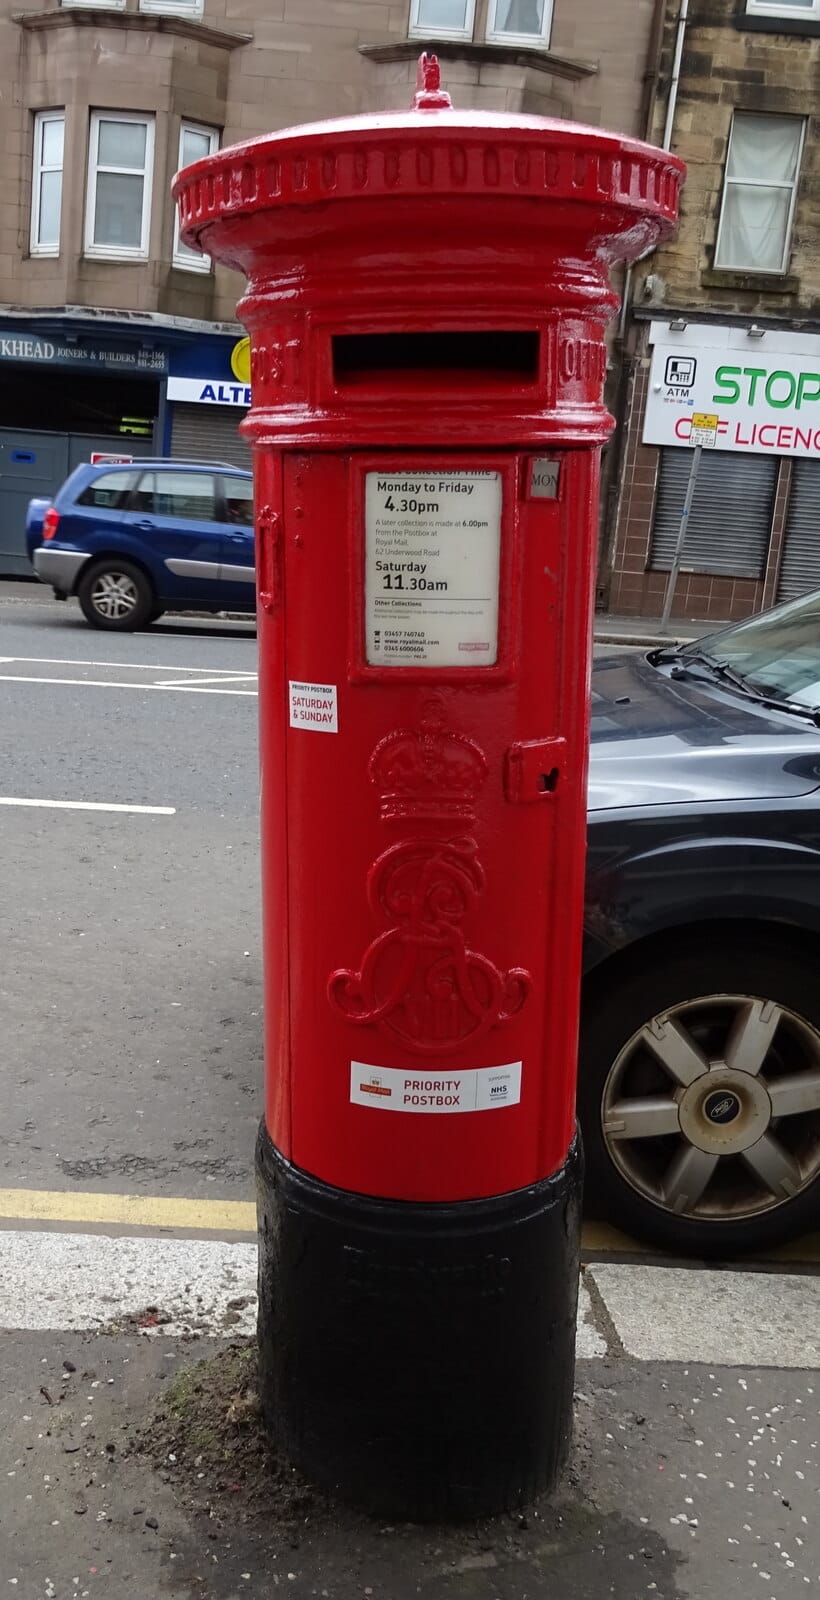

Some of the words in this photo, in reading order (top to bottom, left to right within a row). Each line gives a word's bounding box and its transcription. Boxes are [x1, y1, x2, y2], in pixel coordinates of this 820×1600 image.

[0, 339, 55, 359] KHEAD
[57, 347, 88, 359] JOINERS
[99, 352, 136, 363] BUILDERS
[666, 387, 690, 397] ATM
[377, 481, 421, 494] Monday
[424, 483, 435, 492] to
[439, 482, 474, 495] Friday
[384, 495, 439, 514] 4.30pm
[462, 520, 489, 529] 6.00pm
[393, 529, 403, 537] the
[404, 529, 430, 537] Postbox
[376, 538, 393, 547] Royal
[385, 549, 422, 557] Underwood
[375, 561, 427, 574] Saturday
[383, 574, 448, 591] 11.30am
[392, 600, 422, 608] Collections
[292, 696, 334, 710] SATURDAY
[293, 709, 298, 719] &
[300, 710, 333, 723] SUNDAY
[404, 1079, 461, 1092] PRIORITY
[491, 1085, 508, 1094] NHS
[403, 1095, 460, 1106] POSTBOX
